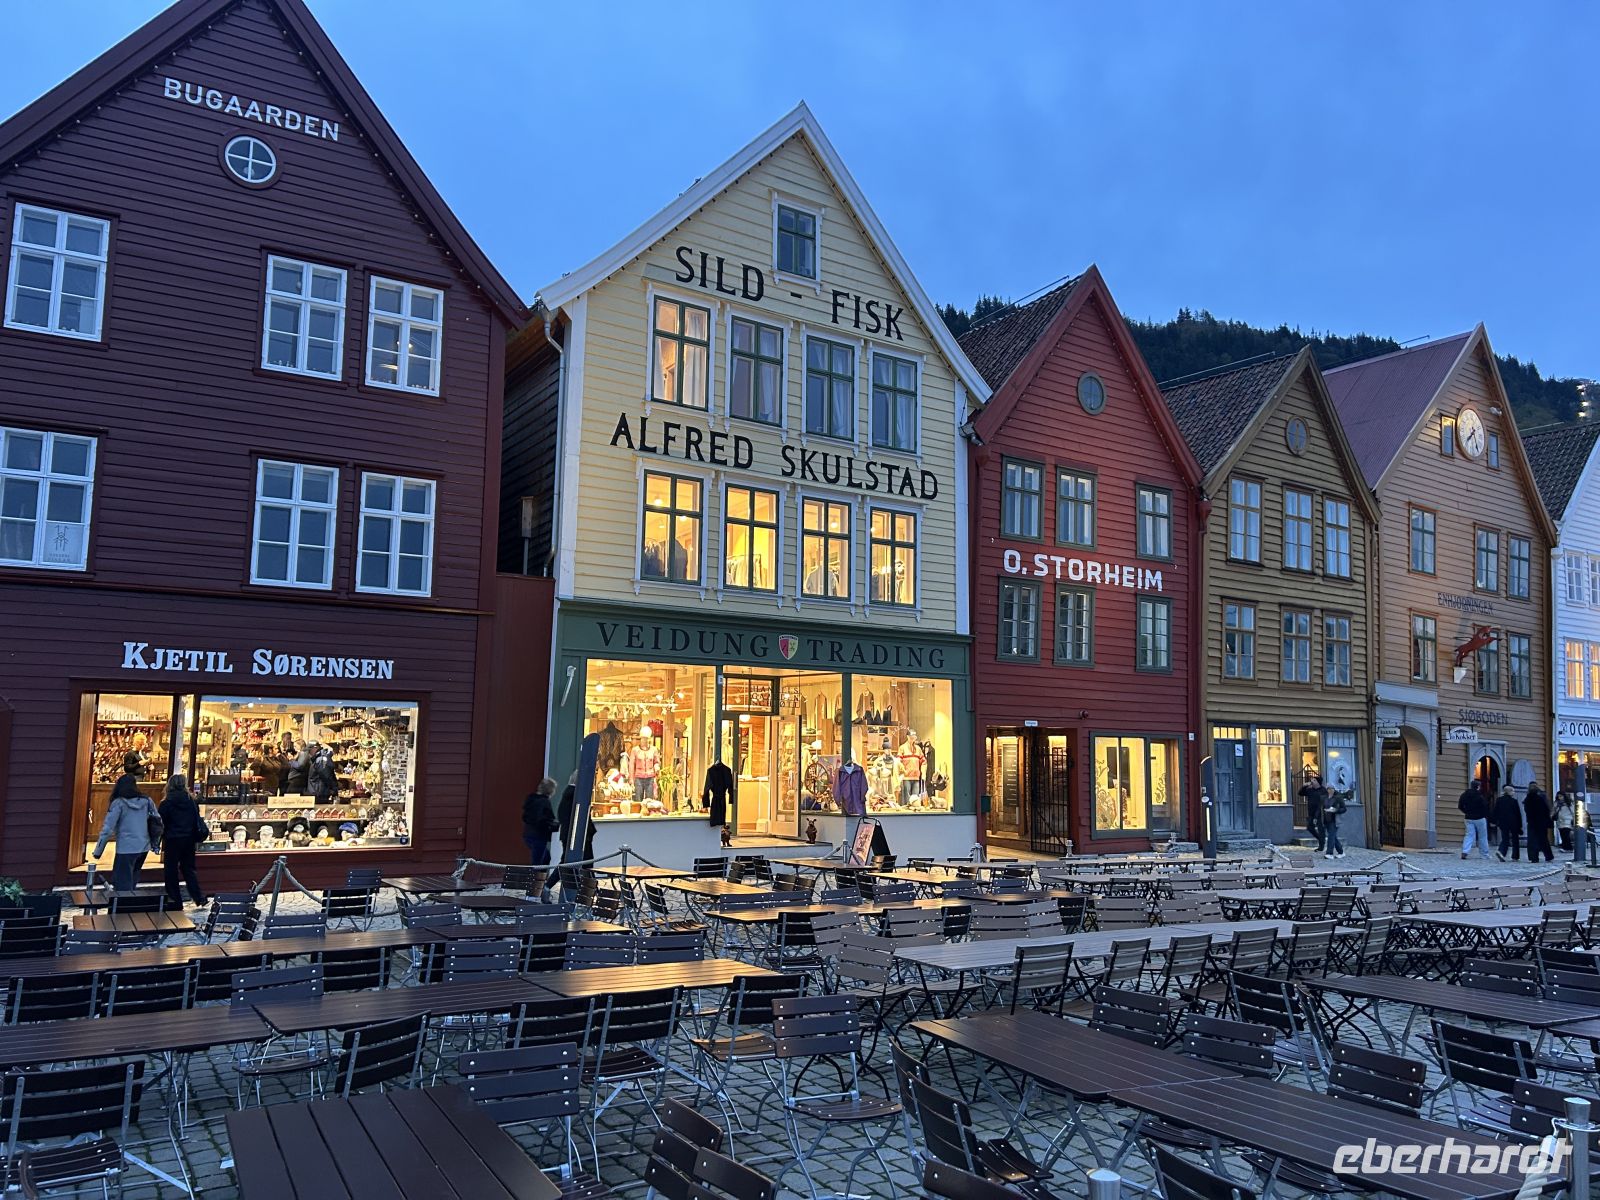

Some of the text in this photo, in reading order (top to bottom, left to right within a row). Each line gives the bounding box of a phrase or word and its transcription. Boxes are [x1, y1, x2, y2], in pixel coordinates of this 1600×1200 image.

[164, 77, 340, 142] BUGAARDEN
[675, 246, 765, 302] SILD
[831, 289, 905, 342] FISK
[610, 412, 939, 501] ALFRED SKULSTAD
[1003, 549, 1164, 592] O. STORHEIM
[121, 641, 234, 674] KJETIL
[596, 621, 946, 669] VEIDUNG TRADING
